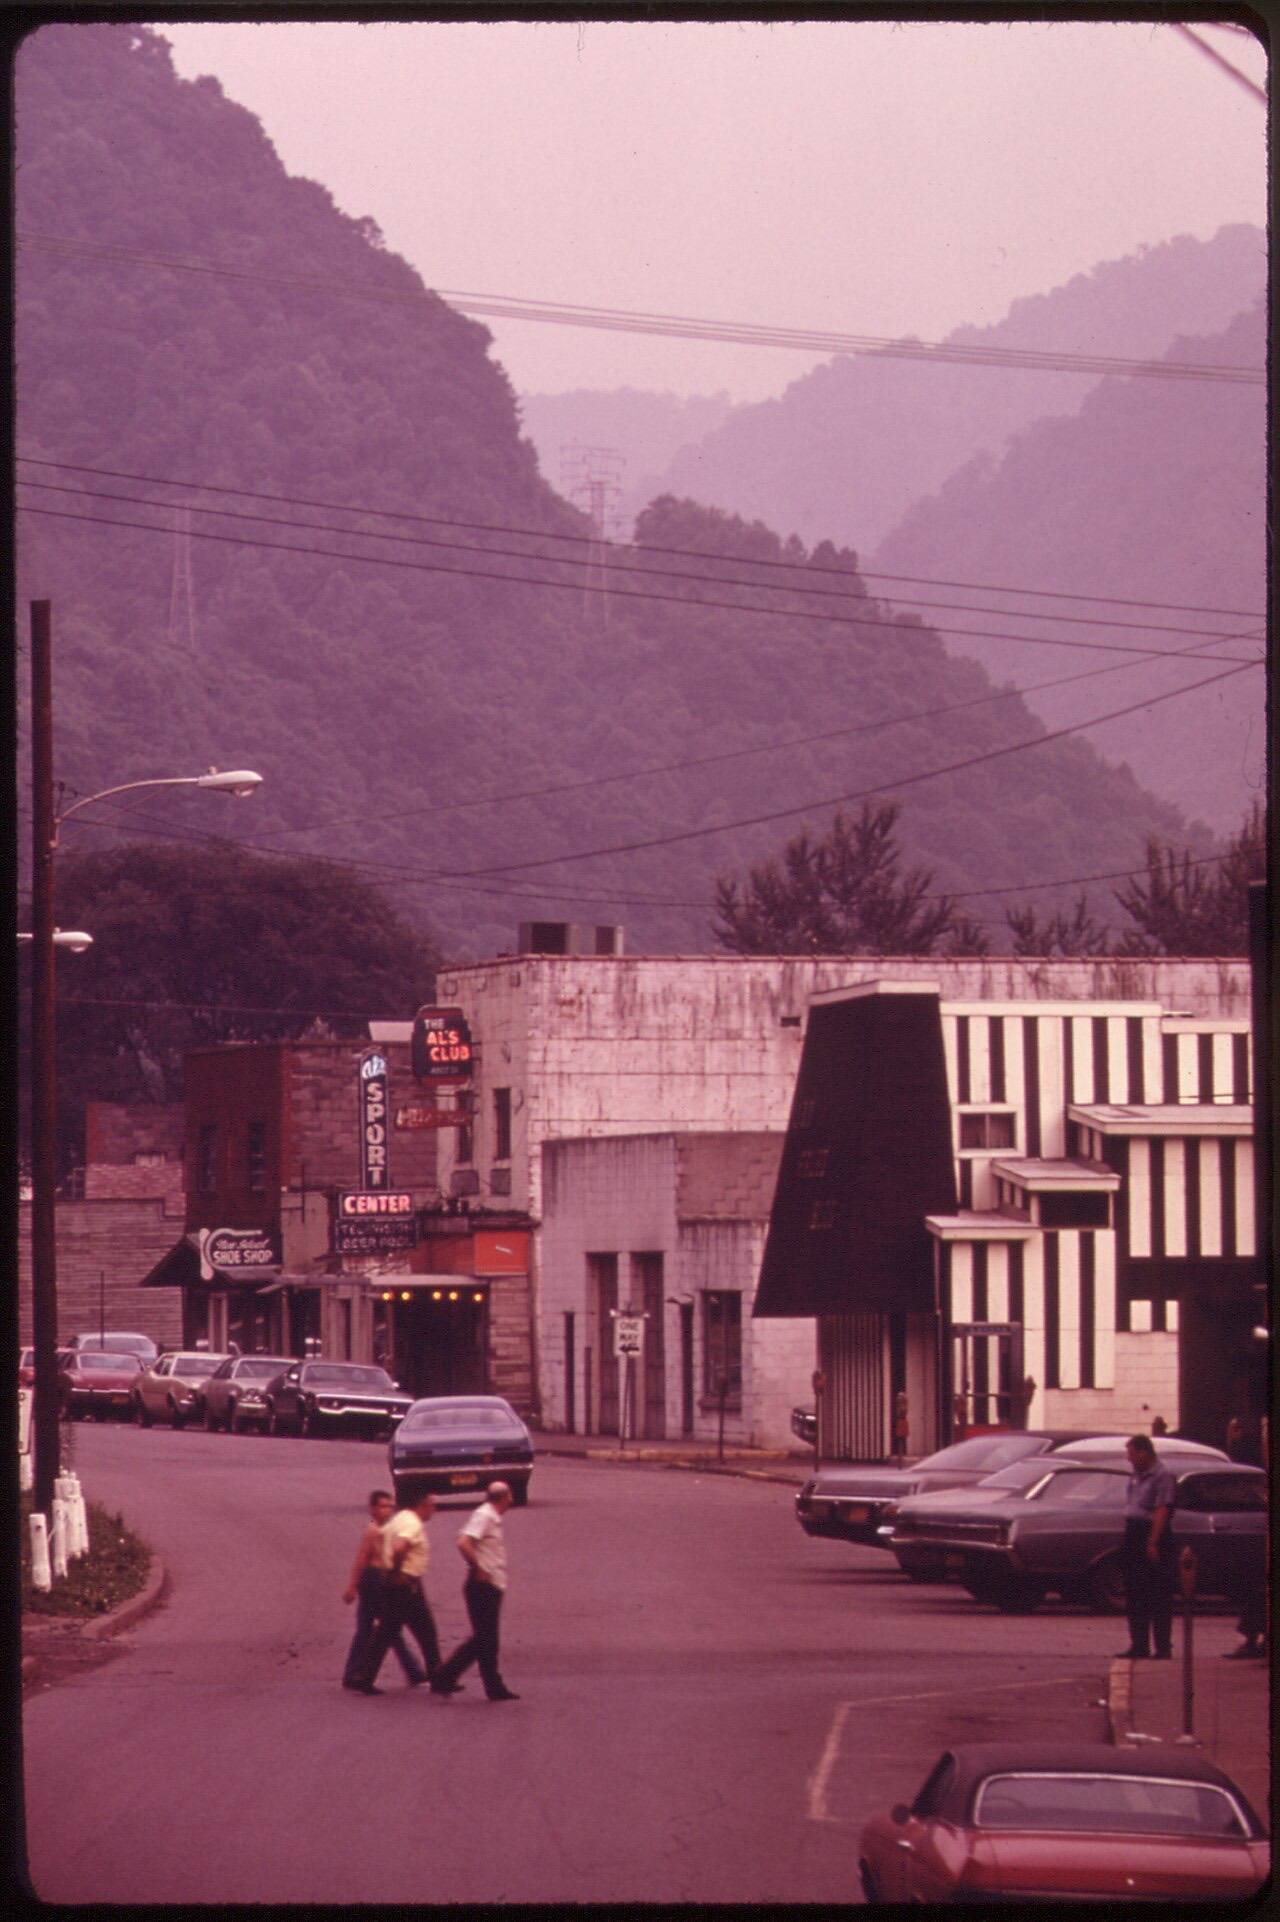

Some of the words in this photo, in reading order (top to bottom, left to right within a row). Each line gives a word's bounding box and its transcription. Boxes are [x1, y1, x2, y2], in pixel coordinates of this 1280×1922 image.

[423, 1018, 445, 1030] THE
[430, 1045, 470, 1062] CLUB
[366, 1082, 385, 1185] SPORT
[344, 1194, 411, 1214] CENTER
[213, 1249, 241, 1264] SHOE
[243, 1249, 273, 1263] SHOP
[619, 1321, 640, 1332] ONE
